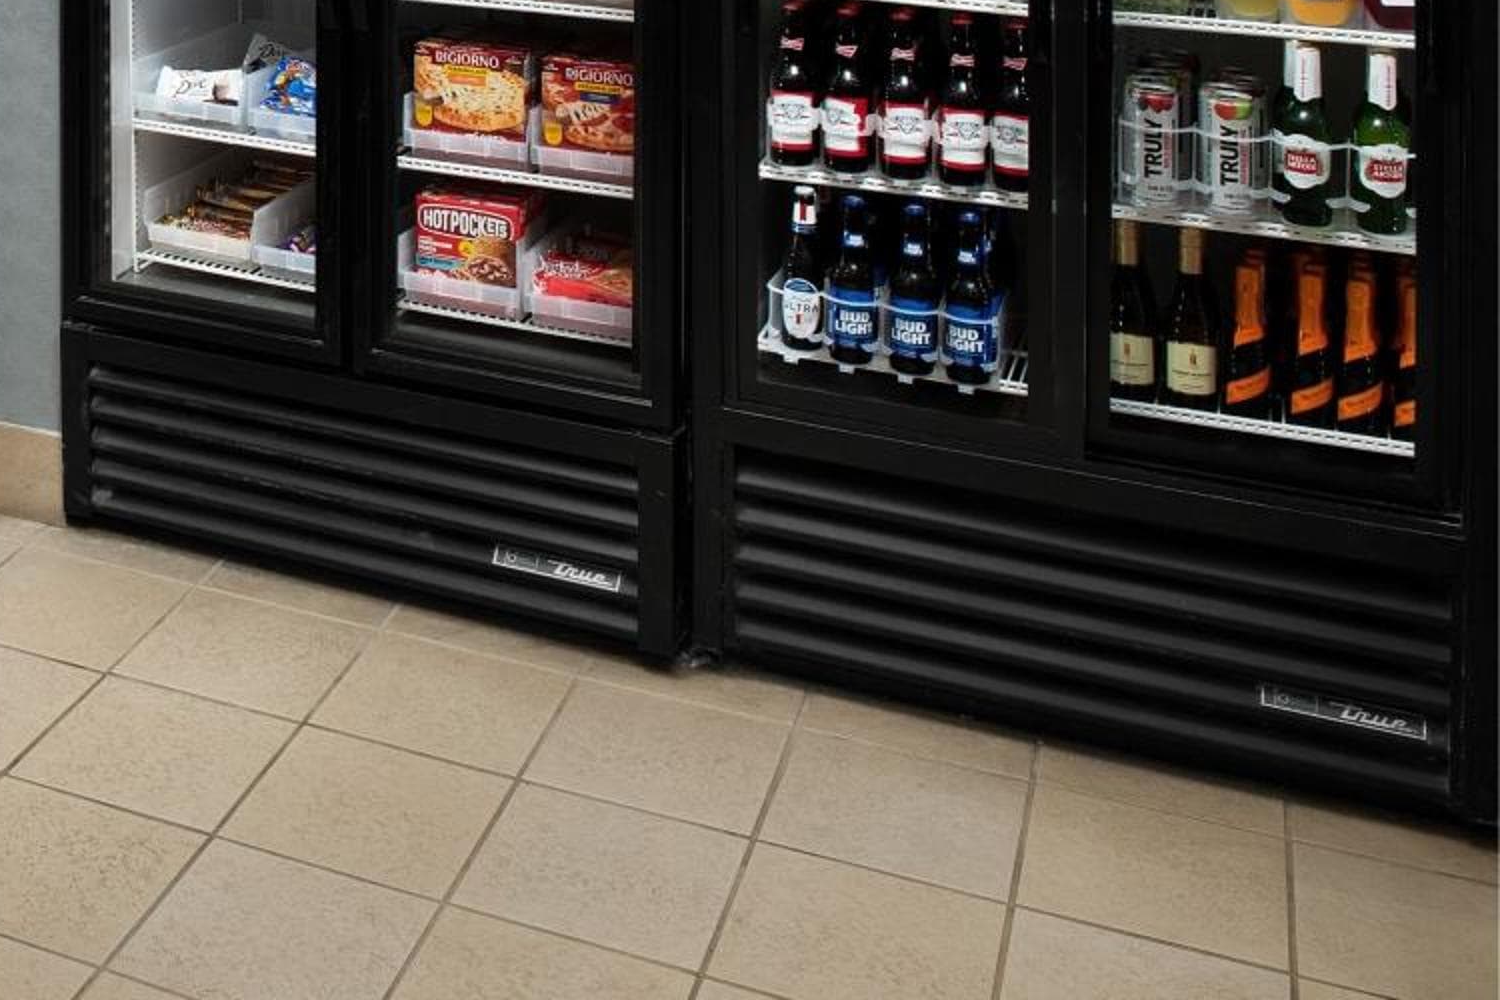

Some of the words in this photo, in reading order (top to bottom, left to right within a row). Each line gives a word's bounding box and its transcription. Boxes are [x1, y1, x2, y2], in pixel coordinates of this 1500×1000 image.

[1144, 118, 1162, 178] TRULY
[1220, 125, 1238, 186] TRULY
[423, 208, 451, 230] HOT
[451, 211, 508, 239] POCKETS
[835, 321, 873, 335] LIGHT
[839, 310, 870, 323] BUD
[895, 317, 927, 332] BUD
